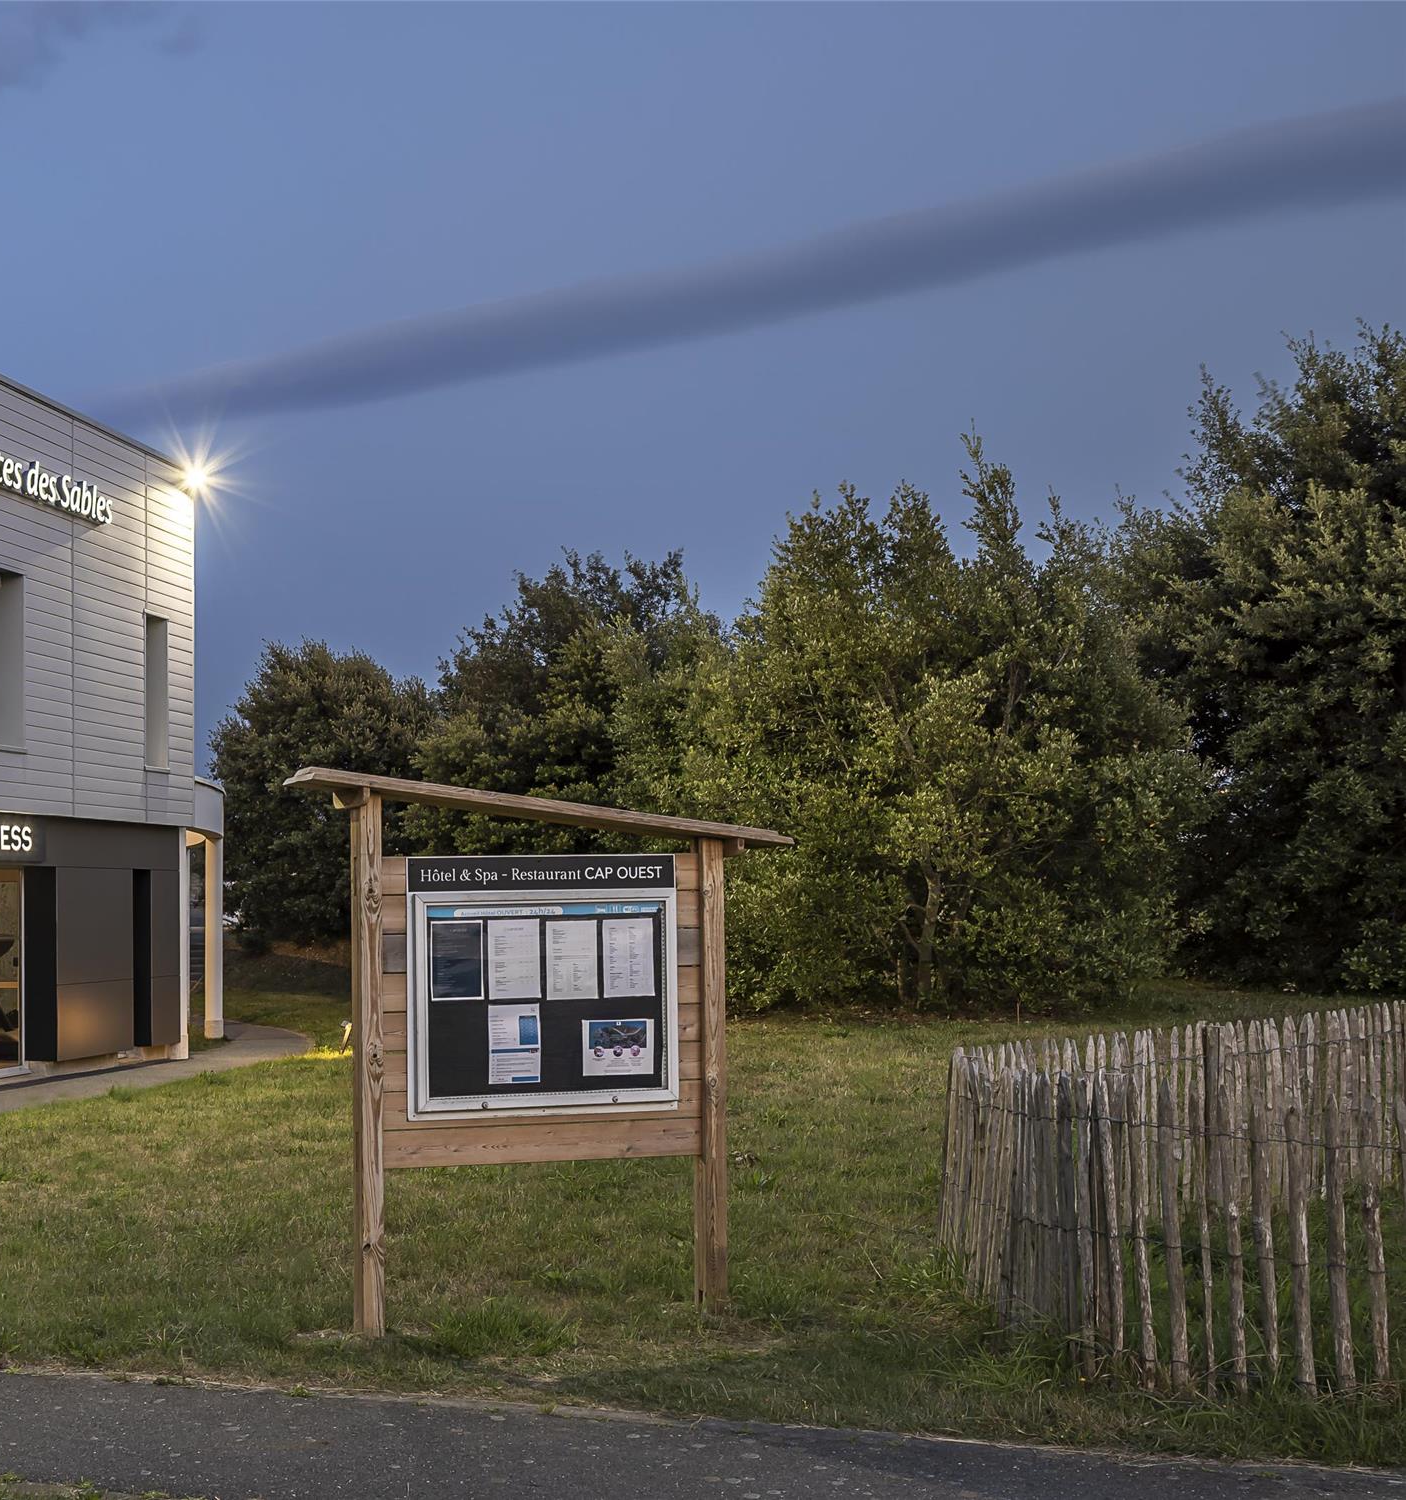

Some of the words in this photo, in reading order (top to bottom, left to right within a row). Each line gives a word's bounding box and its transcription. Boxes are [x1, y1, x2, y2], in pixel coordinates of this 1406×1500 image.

[26, 460, 61, 503] des
[60, 474, 113, 525] Sables
[420, 868, 456, 882] Hôtel
[459, 868, 472, 882] &
[474, 867, 498, 885] Spa
[511, 867, 582, 881] Restaurant
[584, 866, 613, 880] CAP
[616, 866, 663, 879] OUEST
